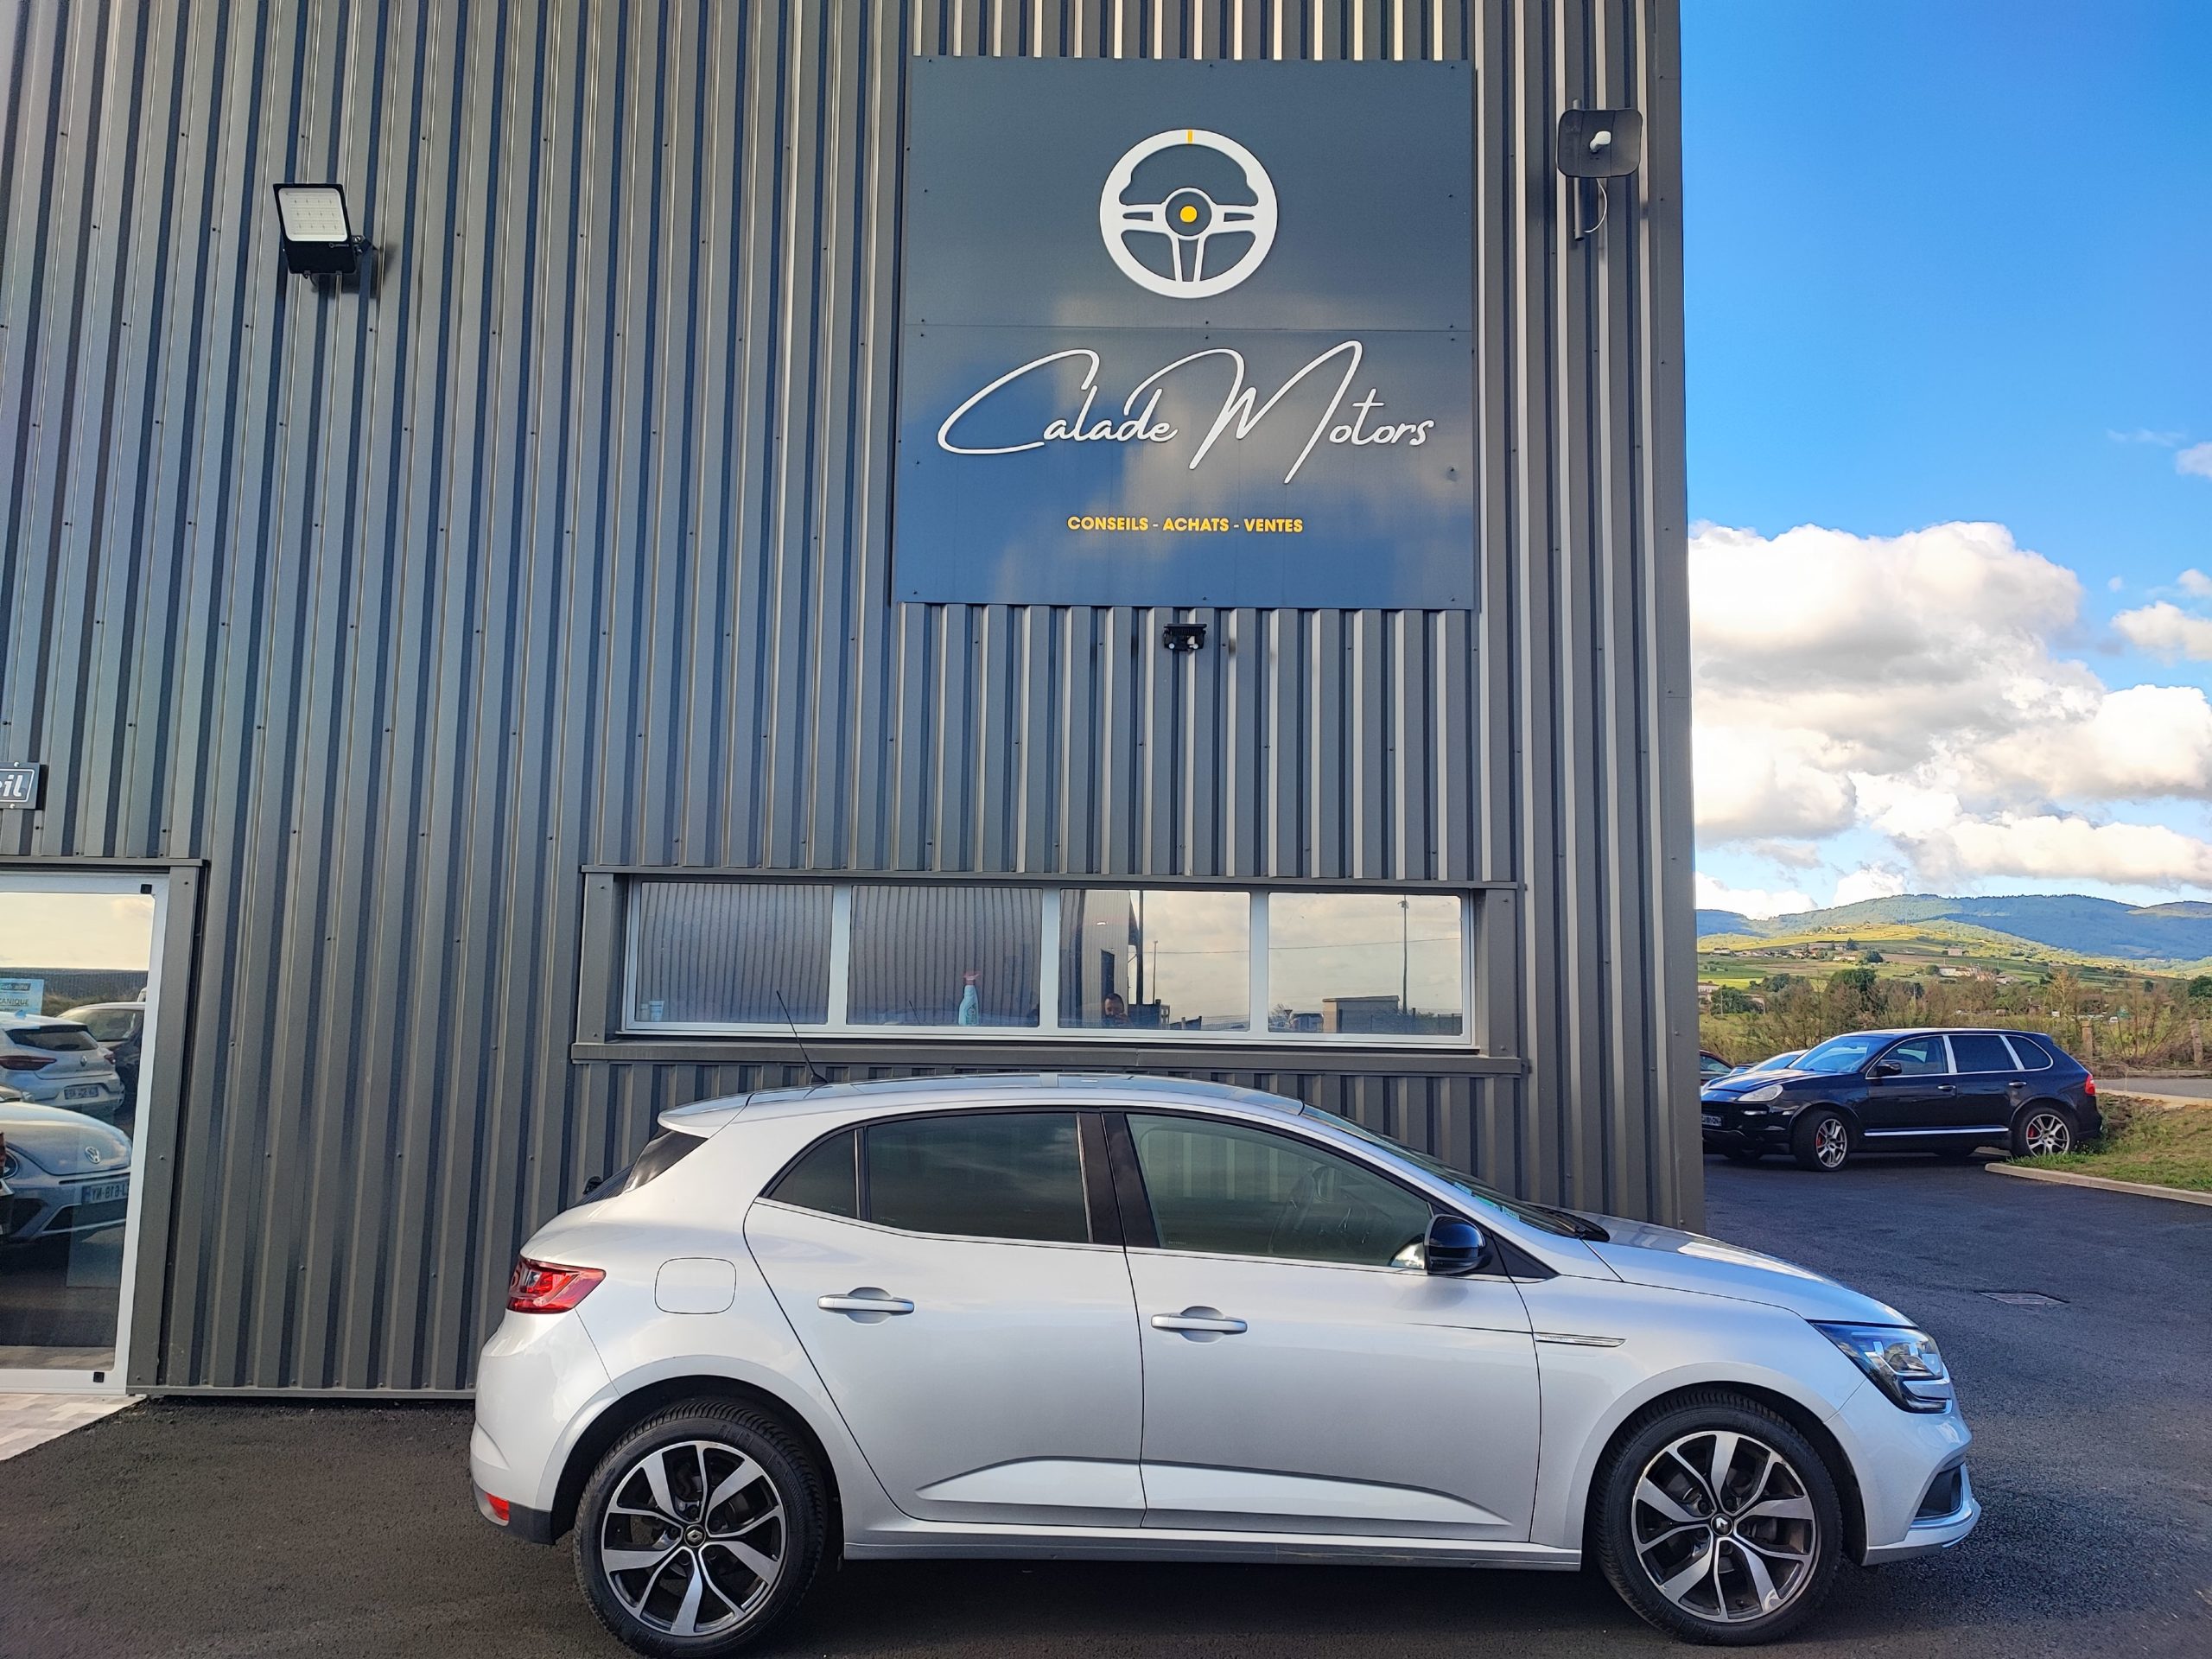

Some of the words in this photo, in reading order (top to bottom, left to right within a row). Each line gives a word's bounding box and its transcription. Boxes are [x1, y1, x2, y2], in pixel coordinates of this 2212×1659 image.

[937, 347, 1179, 454] Calade
[1123, 340, 1434, 485] Motors
[1067, 516, 1148, 531] CONSEILS
[1163, 518, 1230, 531] ACHATS
[1244, 518, 1303, 533] VENTES
[0, 774, 23, 797] il
